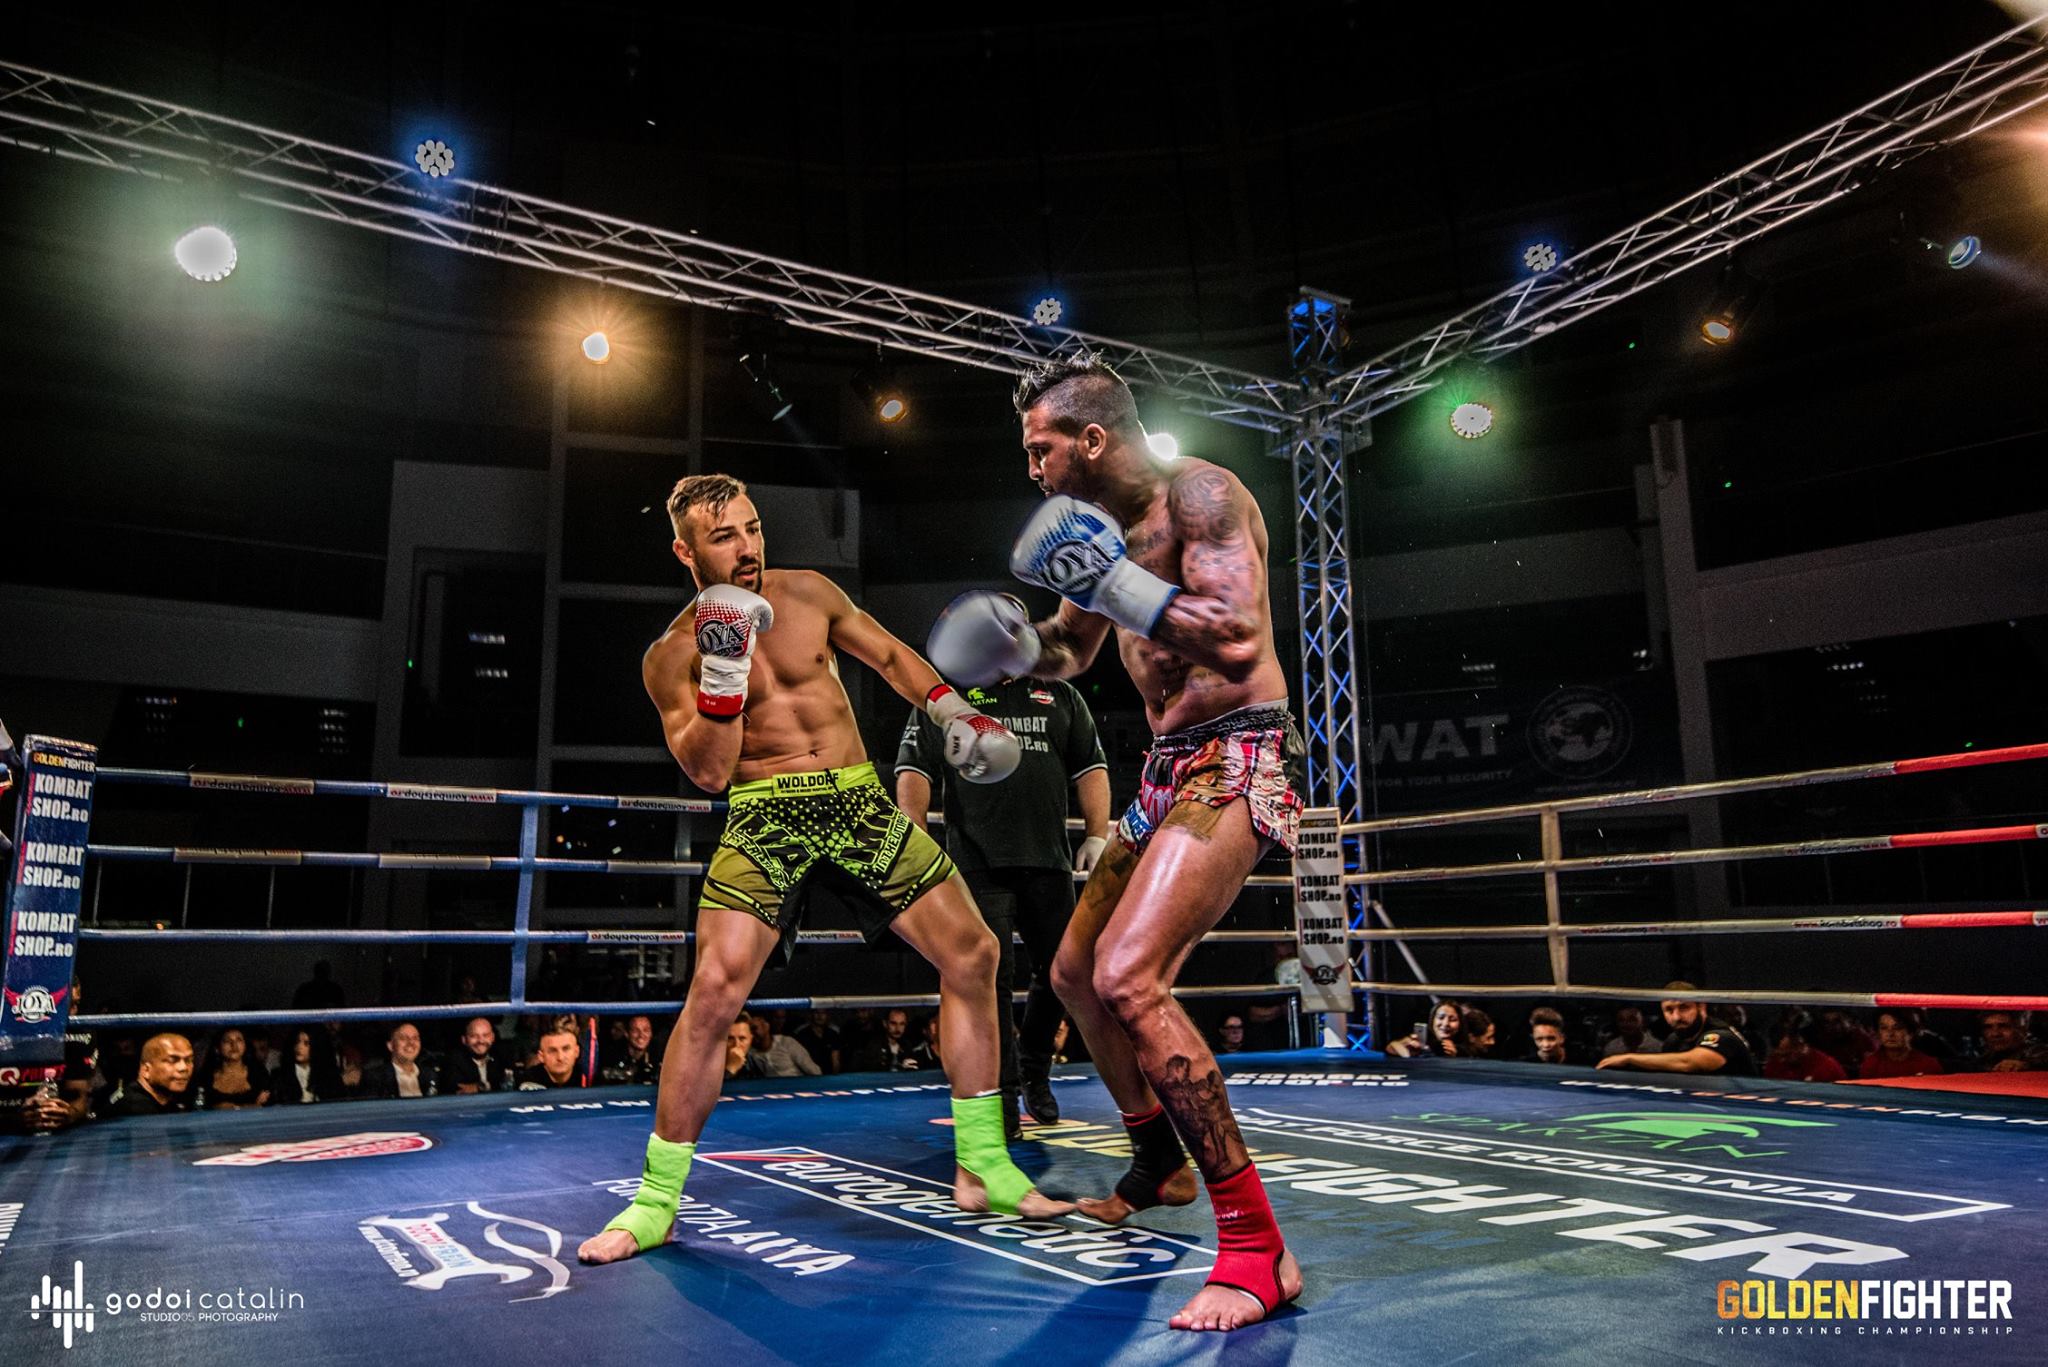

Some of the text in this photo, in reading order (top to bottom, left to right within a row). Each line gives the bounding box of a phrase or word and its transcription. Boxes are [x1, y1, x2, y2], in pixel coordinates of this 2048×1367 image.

[697, 624, 746, 653] OYA
[969, 697, 998, 707] ARTAN
[1018, 736, 1049, 753] OP.RO
[33, 751, 96, 773] GOLDENFIGHTER
[35, 772, 92, 800] KOMBAT
[1298, 832, 1337, 845] KOMBAT
[26, 841, 85, 866] KOMBAT
[1300, 875, 1340, 887] KOMBAT
[17, 911, 77, 933] KOMBAT
[1303, 917, 1343, 929] KOMBAT
[1303, 1126, 1494, 1154] FORCE
[1488, 1150, 1857, 1203] ROMANIA
